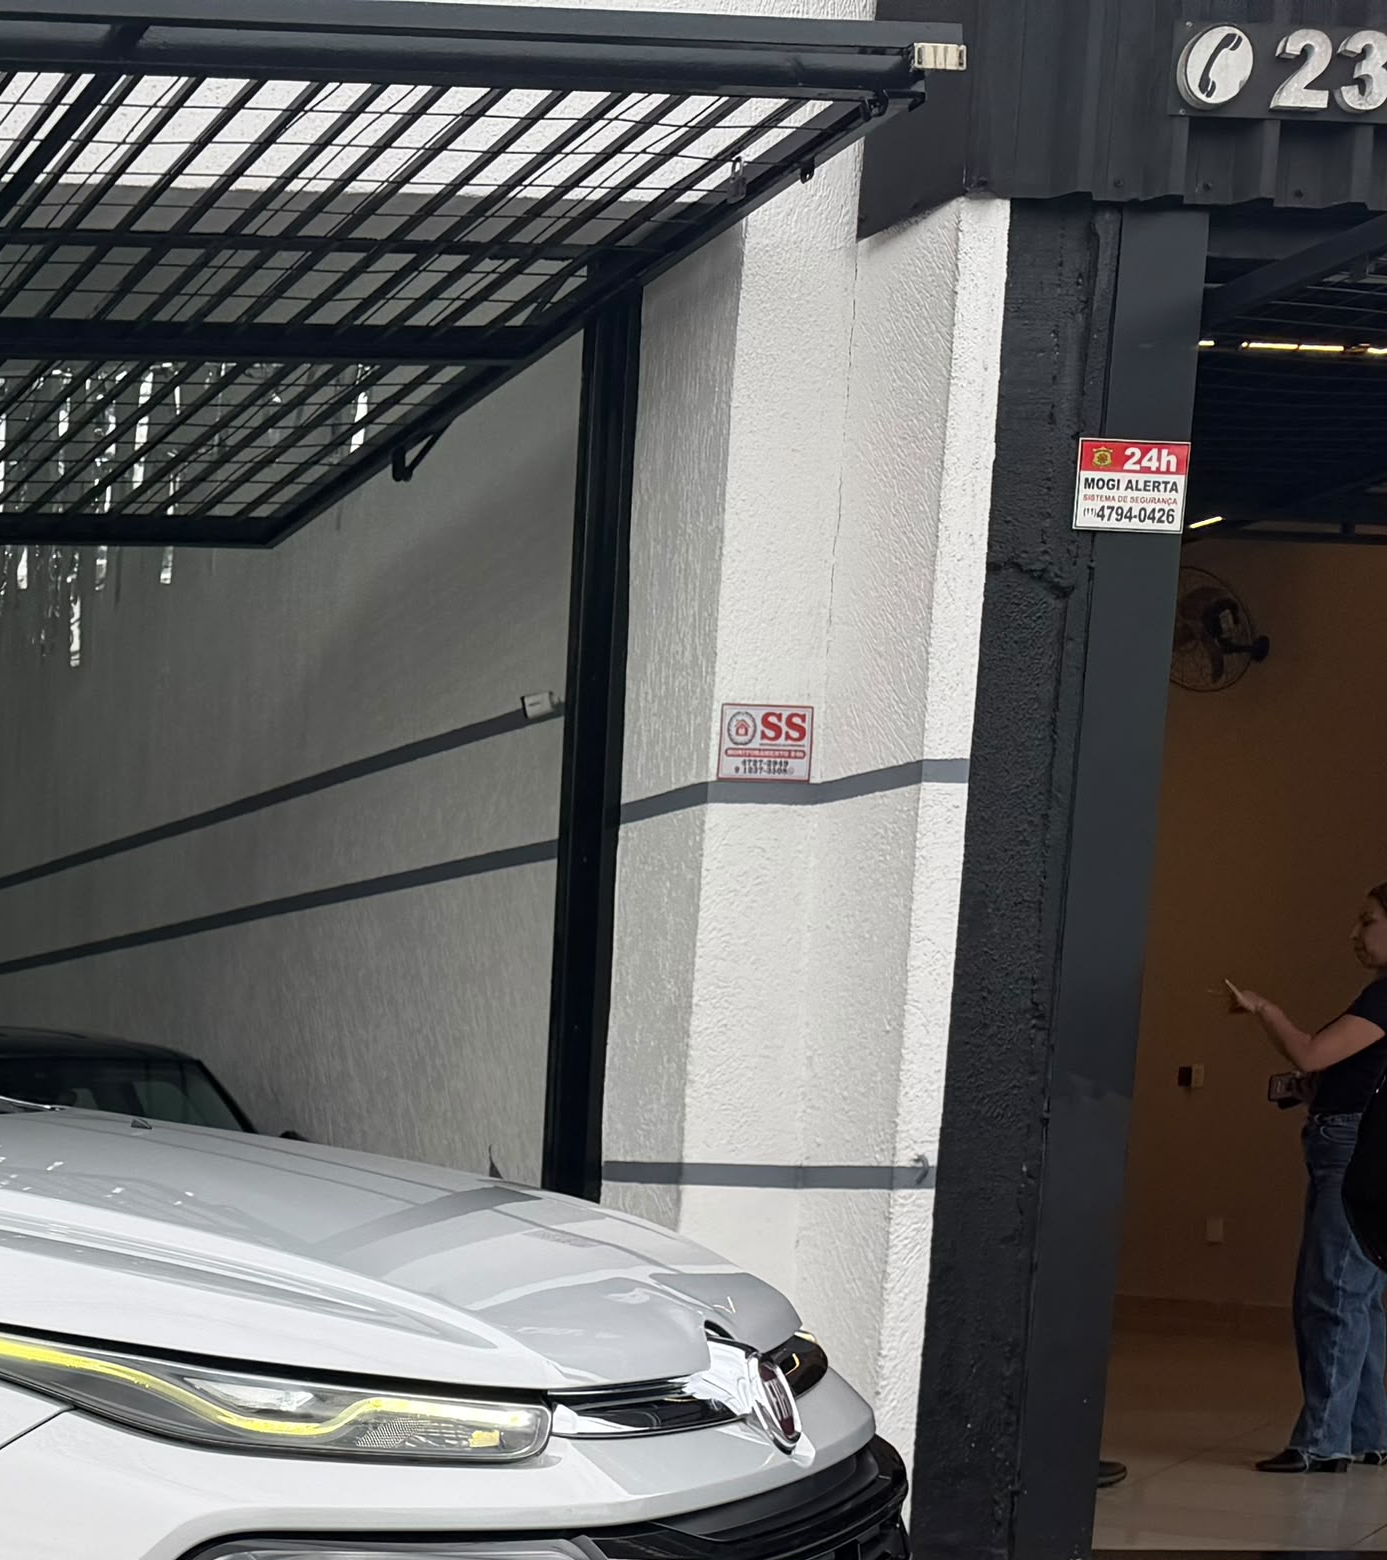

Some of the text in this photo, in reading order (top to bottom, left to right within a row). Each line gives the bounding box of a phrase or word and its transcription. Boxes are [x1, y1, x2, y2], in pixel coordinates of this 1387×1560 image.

[1269, 28, 1387, 112] 23
[1123, 447, 1178, 472] 24h
[1084, 477, 1179, 494] MOGI ALERTA
[1083, 494, 1178, 506] SISTEMA DE SEGURANÇA
[760, 711, 807, 742] SS
